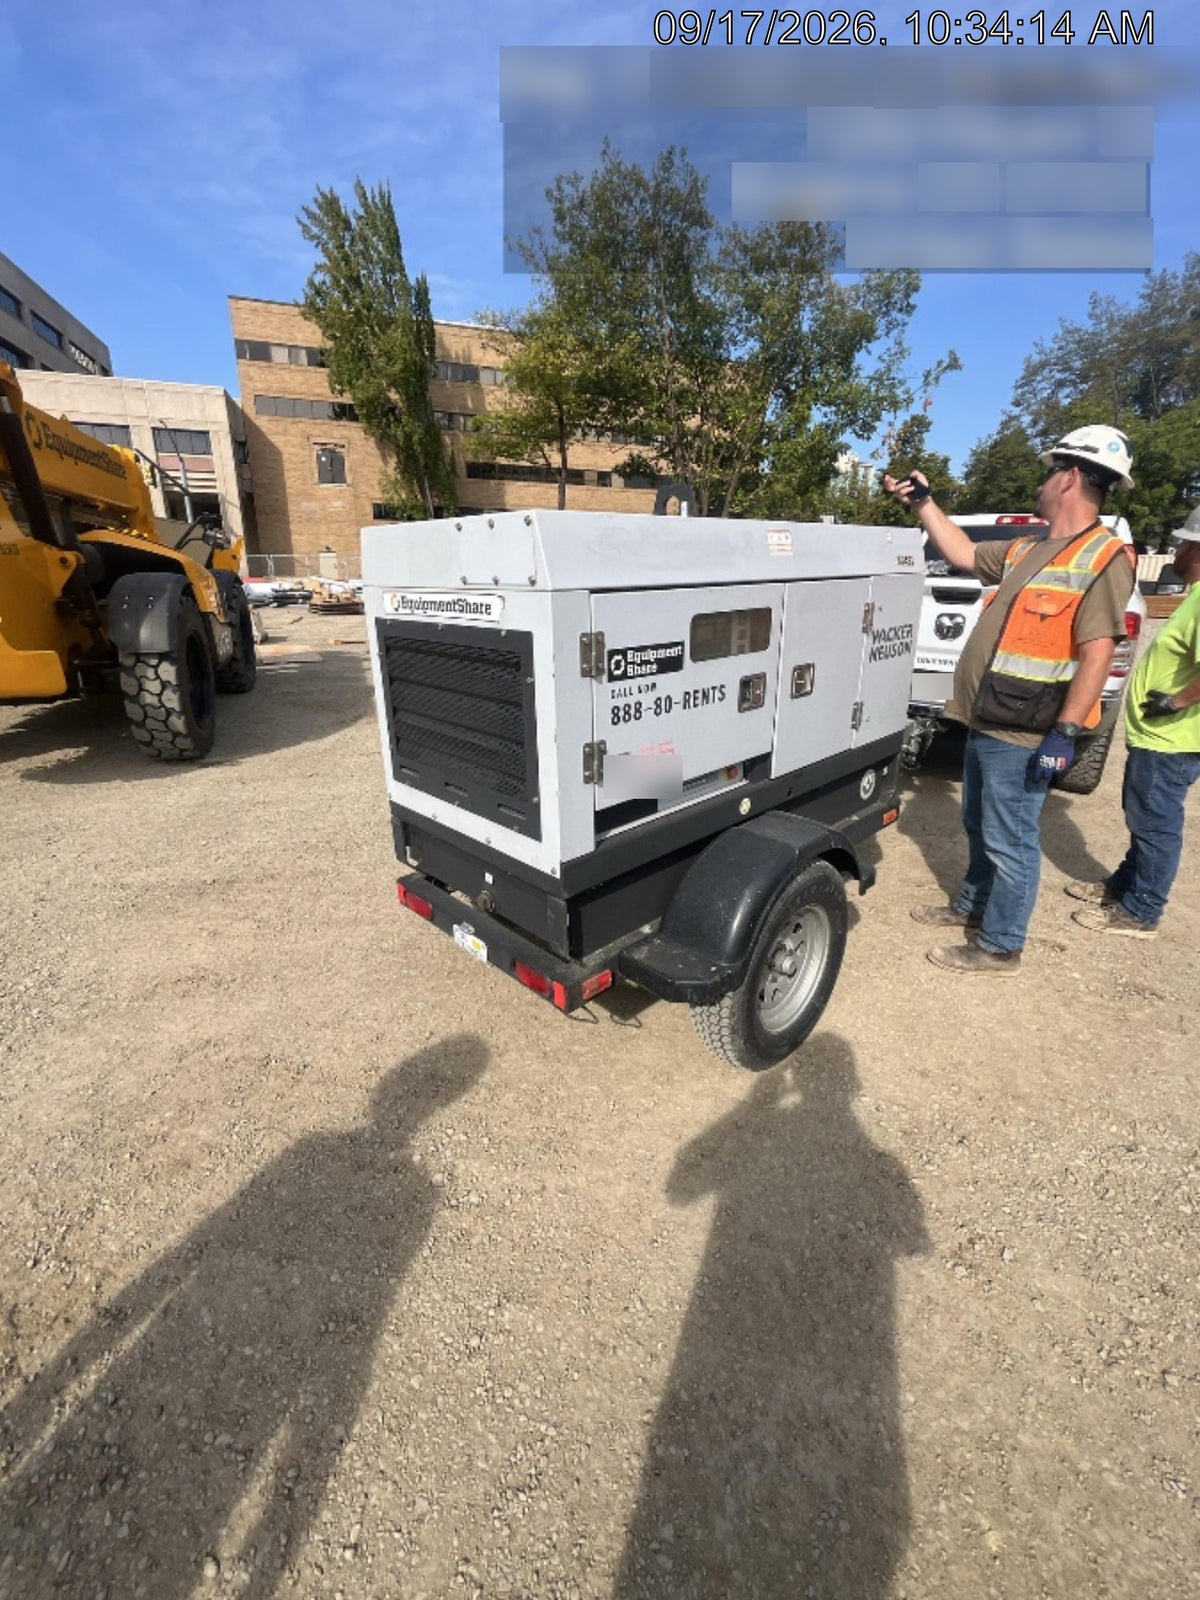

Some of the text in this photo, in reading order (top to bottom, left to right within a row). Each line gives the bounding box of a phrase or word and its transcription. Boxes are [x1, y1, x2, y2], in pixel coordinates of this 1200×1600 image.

[41, 421, 127, 480] EquipmentShare
[400, 595, 492, 616] EquipmentShare
[871, 623, 913, 645] WACKER
[626, 645, 683, 664] Equipment
[869, 640, 913, 663] NEUSON
[626, 663, 658, 677] Share
[610, 682, 657, 699] CALL NOW
[610, 684, 727, 726] 888-80-RENTS
